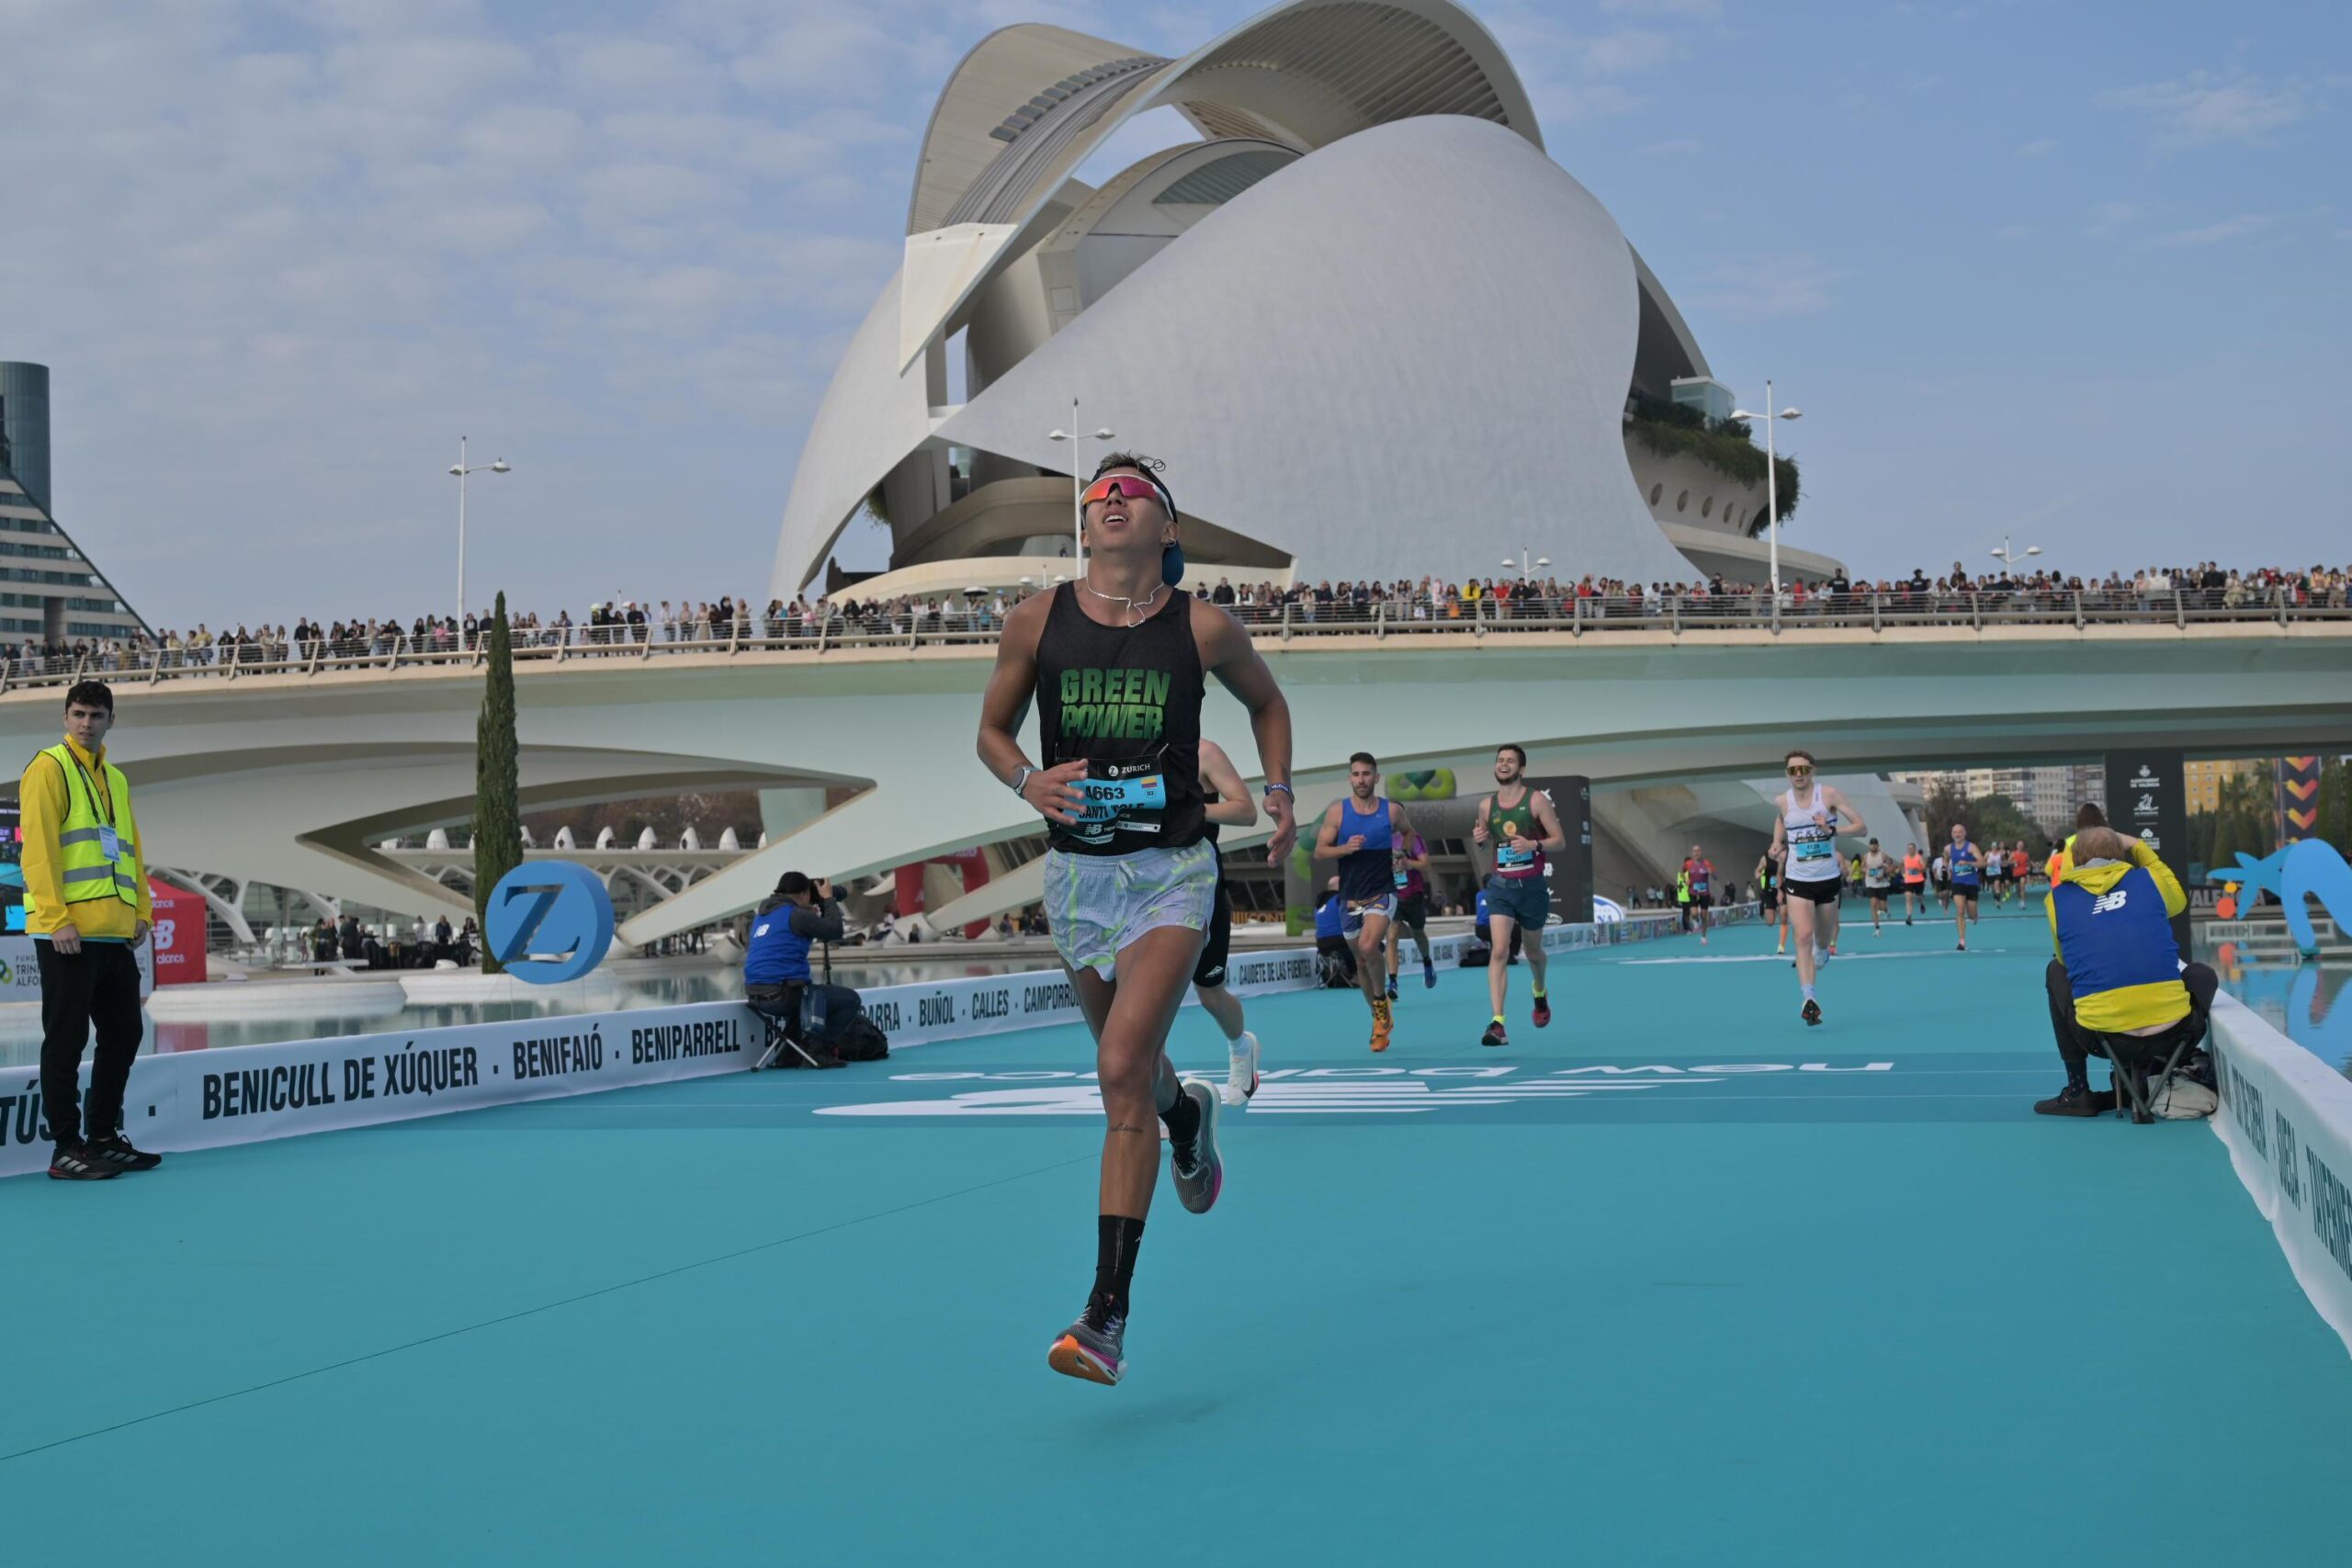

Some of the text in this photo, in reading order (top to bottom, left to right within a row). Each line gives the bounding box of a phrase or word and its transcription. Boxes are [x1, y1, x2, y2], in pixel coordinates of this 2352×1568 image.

[1060, 668, 1171, 705] GREEN
[1060, 704, 1164, 739] POWER
[1122, 763, 1150, 773] ZURICH
[499, 884, 581, 965] Z
[203, 1062, 335, 1120] BENICULL
[345, 1057, 375, 1101] DE
[383, 1041, 479, 1097] XÚQUER
[513, 1023, 603, 1079] BENIFAIÓ
[632, 1020, 740, 1065] BENIPARRELL
[919, 990, 955, 1027] BUÑOL
[972, 989, 1008, 1021] CALLES
[1024, 984, 1080, 1013] CAMPORRO
[1239, 963, 1266, 986] CAUDETE
[1268, 962, 1274, 982] DE
